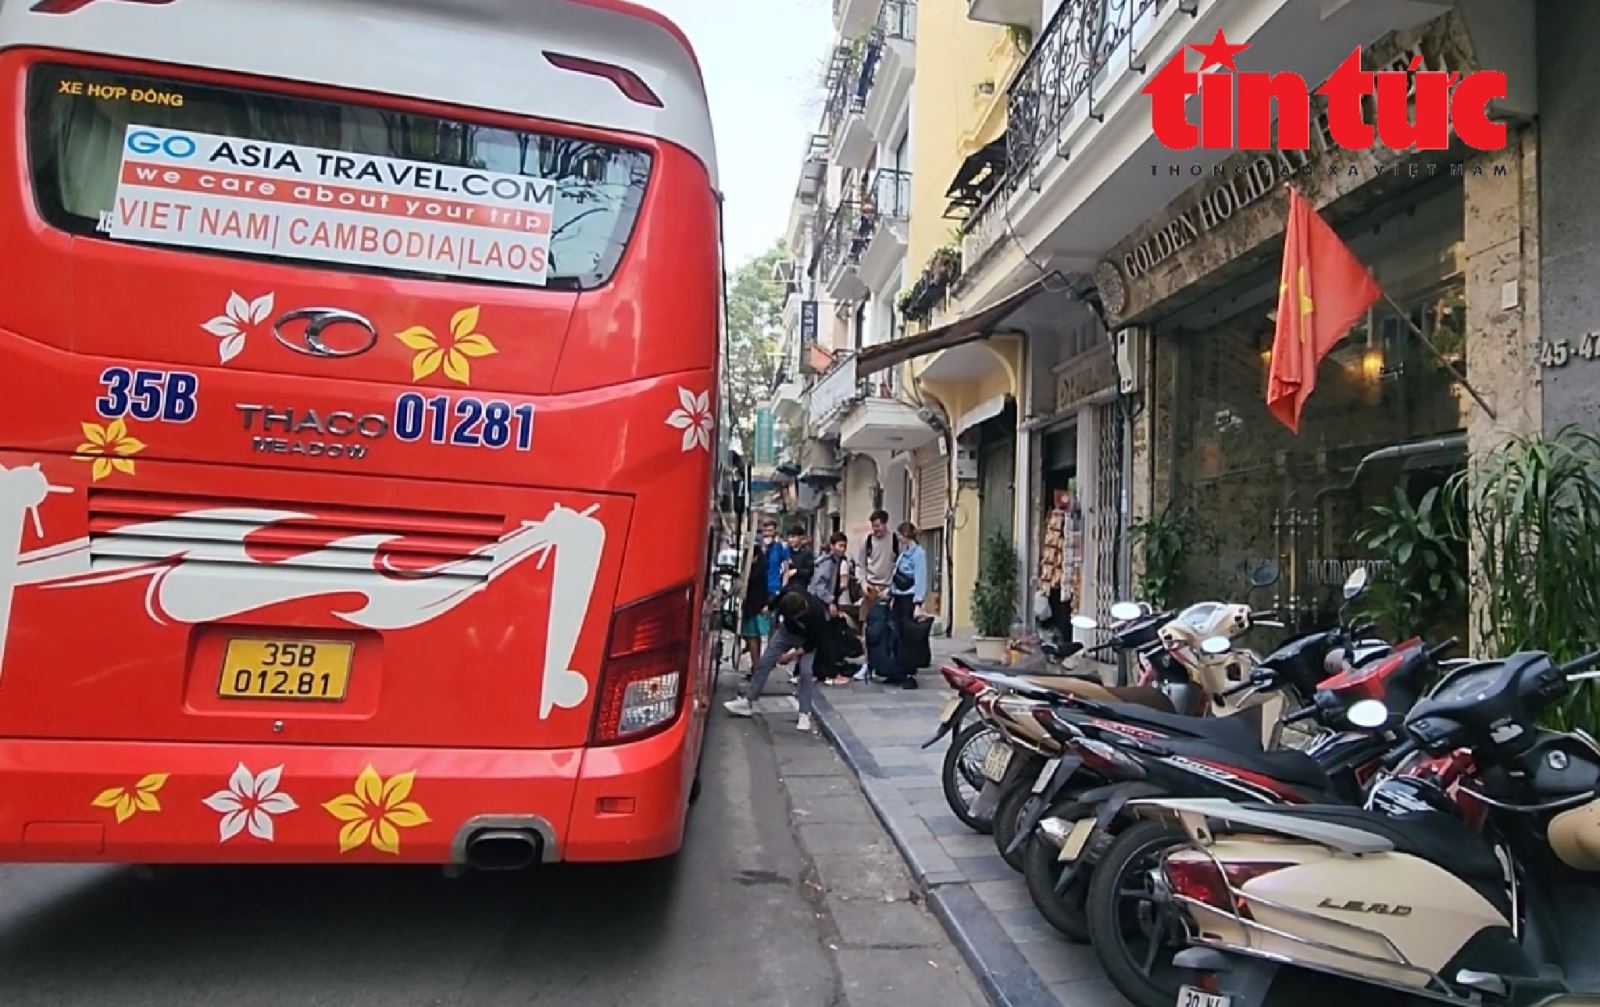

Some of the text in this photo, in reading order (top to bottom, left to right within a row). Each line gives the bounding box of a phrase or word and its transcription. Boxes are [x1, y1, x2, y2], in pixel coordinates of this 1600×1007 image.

[58, 80, 84, 95] XE
[87, 83, 128, 100] HỢP
[127, 131, 555, 206] GO ASIA TRAVEL.COM
[118, 198, 192, 232] VIET
[136, 167, 542, 231] we care about your trip
[1124, 209, 1198, 280] GOLDEN
[96, 367, 198, 422] 35B
[235, 402, 388, 439] THACO
[394, 391, 536, 451] 01281
[251, 435, 369, 460] MEADOW
[262, 643, 316, 667] 35B
[234, 669, 330, 695] 012.81
[1317, 897, 1412, 916] LEAD
